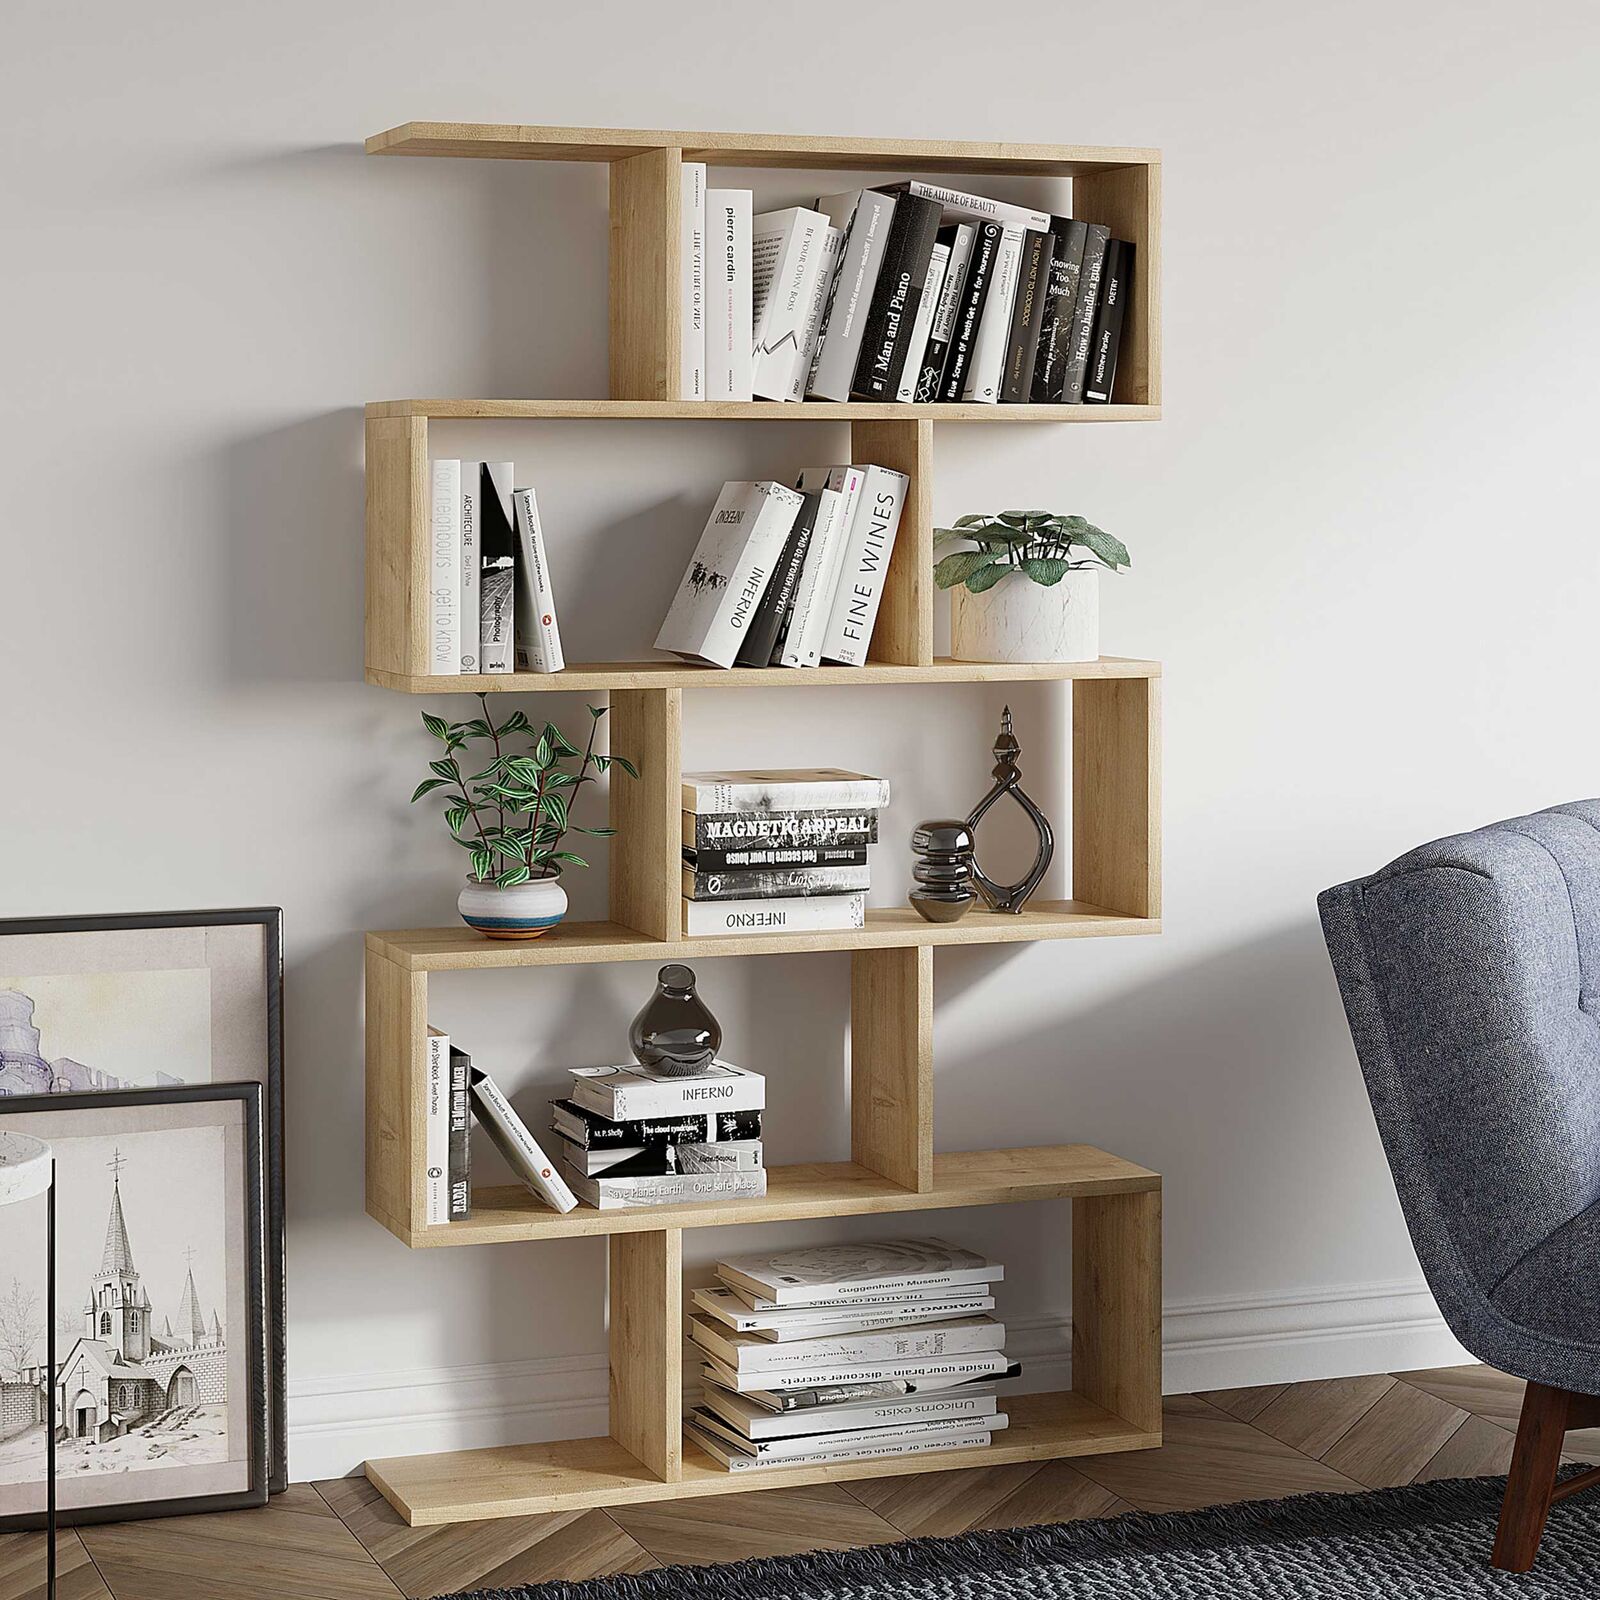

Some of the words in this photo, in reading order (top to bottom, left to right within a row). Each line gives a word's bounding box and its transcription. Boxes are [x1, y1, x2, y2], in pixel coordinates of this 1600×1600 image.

[918, 185, 933, 198] THE
[933, 189, 959, 205] ALLURE
[959, 197, 969, 207] OF
[969, 198, 997, 214] BEAUTY
[725, 207, 736, 242] pierre
[806, 227, 814, 237] BE
[1033, 237, 1041, 249] THE
[799, 240, 811, 263] YOUR
[1031, 249, 1039, 266] HOW
[726, 245, 736, 282] cardin
[792, 264, 805, 289] OWN
[1029, 266, 1037, 280] NOT
[1055, 271, 1070, 283] Too
[973, 276, 984, 289] for
[1027, 280, 1035, 290] TO
[1049, 284, 1071, 297] Much
[890, 272, 911, 311] Piano
[971, 291, 979, 304] one
[1108, 278, 1119, 305] POETRY
[786, 291, 799, 312] BOSS
[1021, 289, 1034, 327] COOKBOOK
[1080, 290, 1095, 325] handle
[966, 306, 977, 320] Get
[887, 311, 901, 339] and
[961, 319, 973, 340] Death
[1081, 325, 1090, 338] to
[958, 342, 967, 352] Of
[1076, 338, 1088, 361] How
[1101, 330, 1112, 353] Parsley
[875, 341, 894, 372] Man
[951, 353, 964, 379] Screen
[1096, 354, 1108, 384] Matthew
[947, 380, 958, 397] Blue
[463, 494, 473, 546] ARCHITECTURE
[431, 497, 456, 568] neighbours
[843, 583, 873, 641] FINE
[859, 492, 894, 572] WINES
[430, 588, 456, 608] get
[730, 566, 765, 629] INFERNO
[435, 613, 456, 626] to
[493, 596, 503, 642] Photography
[435, 629, 456, 663] know
[706, 818, 799, 839] MAGNETIC
[725, 852, 750, 865] house
[750, 851, 767, 864] your
[766, 850, 775, 863] in
[776, 850, 801, 863] secure
[801, 850, 817, 863] Feel
[787, 872, 814, 890] Story
[726, 911, 786, 928] INFERNO
[431, 1039, 440, 1053] John
[452, 1066, 465, 1091] MAKER
[682, 1085, 734, 1101] INFERNO
[452, 1091, 465, 1118] MOTION
[452, 1117, 465, 1132] THE
[654, 1124, 670, 1134] cloud
[699, 1155, 737, 1163] Photography
[608, 1188, 630, 1200] Save
[630, 1186, 657, 1199] Planet
[659, 1183, 684, 1195] Earth!
[693, 1182, 713, 1193] One
[713, 1180, 733, 1192] safe
[733, 1178, 758, 1193] place
[838, 1281, 904, 1294] Guggenheim
[907, 1277, 950, 1286] Museum
[809, 1298, 848, 1306] WOMEN
[921, 1302, 983, 1311] MAKING
[893, 1368, 925, 1377] brain
[959, 1363, 995, 1371] Inside
[780, 1375, 828, 1385] secrets
[829, 1371, 882, 1381] discover
[819, 1389, 873, 1402] Photography
[874, 1408, 912, 1417] exists
[915, 1400, 975, 1410] Unicorns
[924, 1440, 958, 1448] Screen
